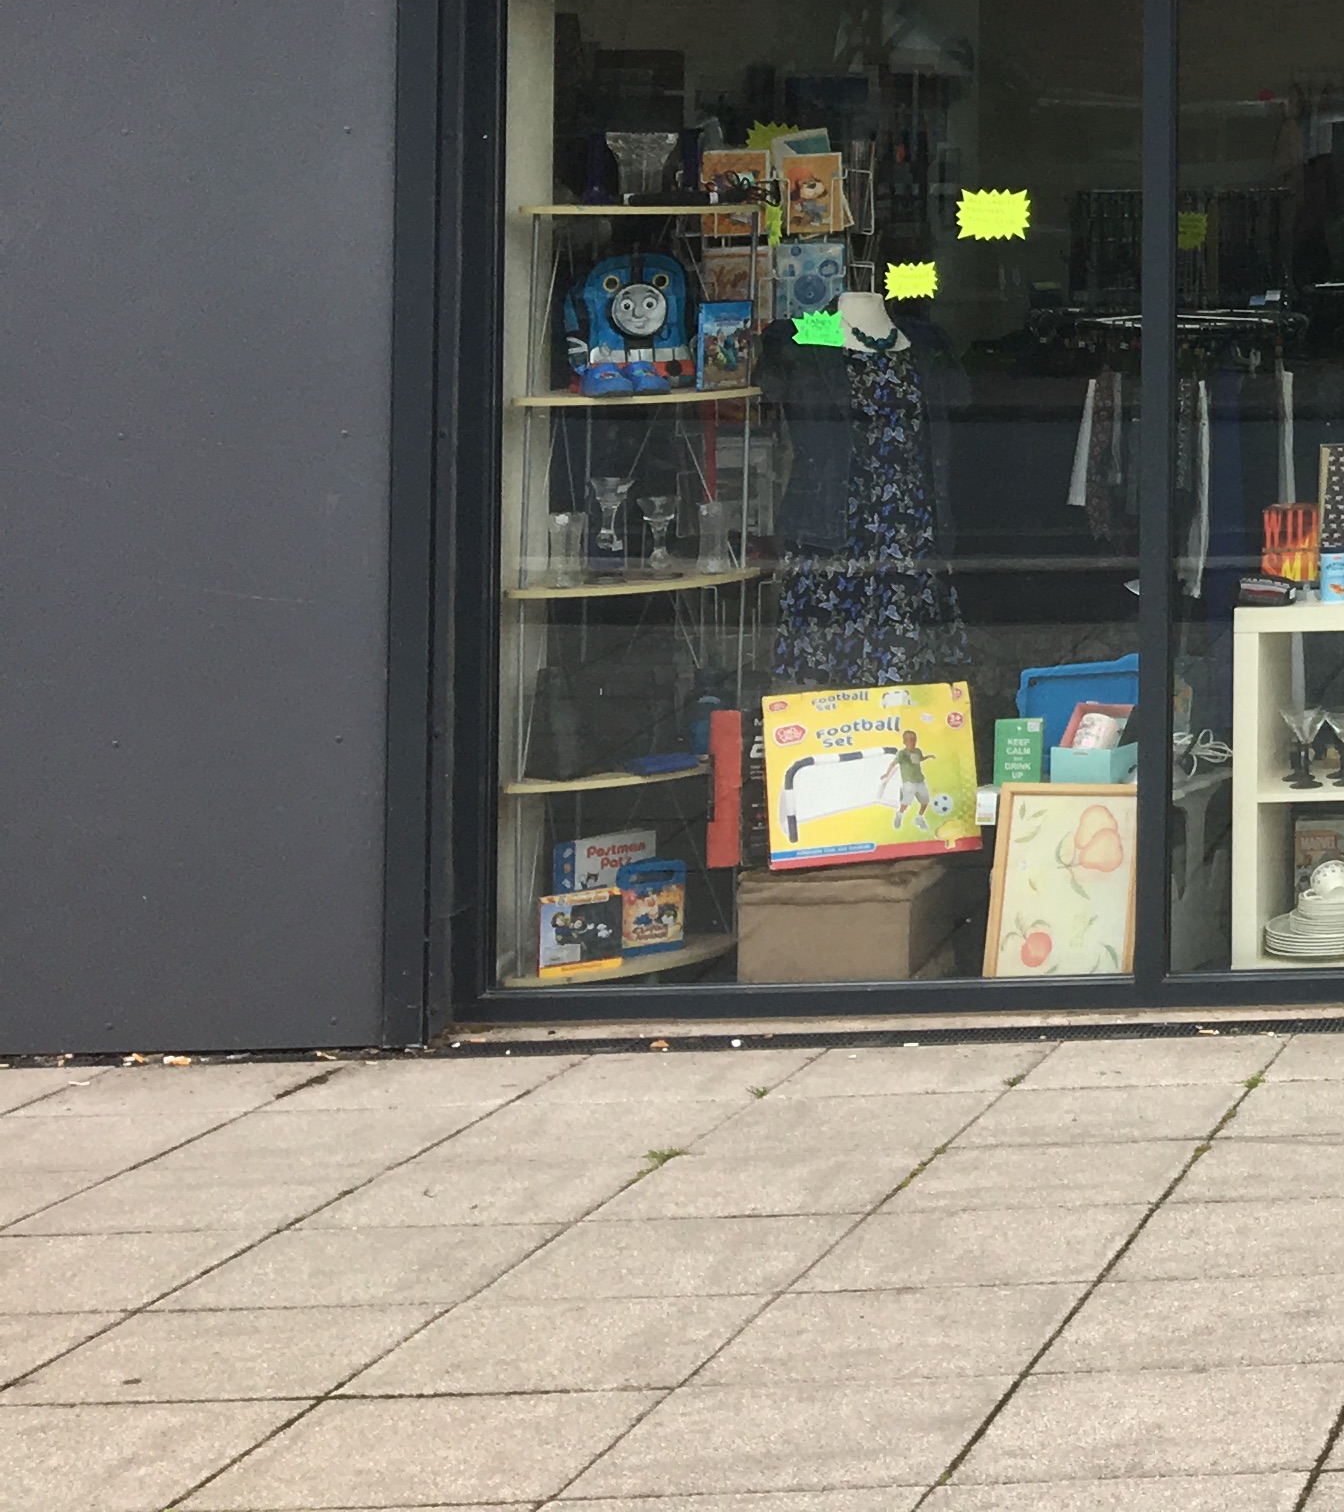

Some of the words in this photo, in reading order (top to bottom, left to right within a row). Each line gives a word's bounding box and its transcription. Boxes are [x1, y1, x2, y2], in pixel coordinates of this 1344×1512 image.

[811, 690, 870, 706] Football
[816, 716, 901, 739] Football
[1007, 738, 1031, 746] KEEP
[1006, 747, 1031, 755] CALM
[586, 841, 646, 859] Postman
